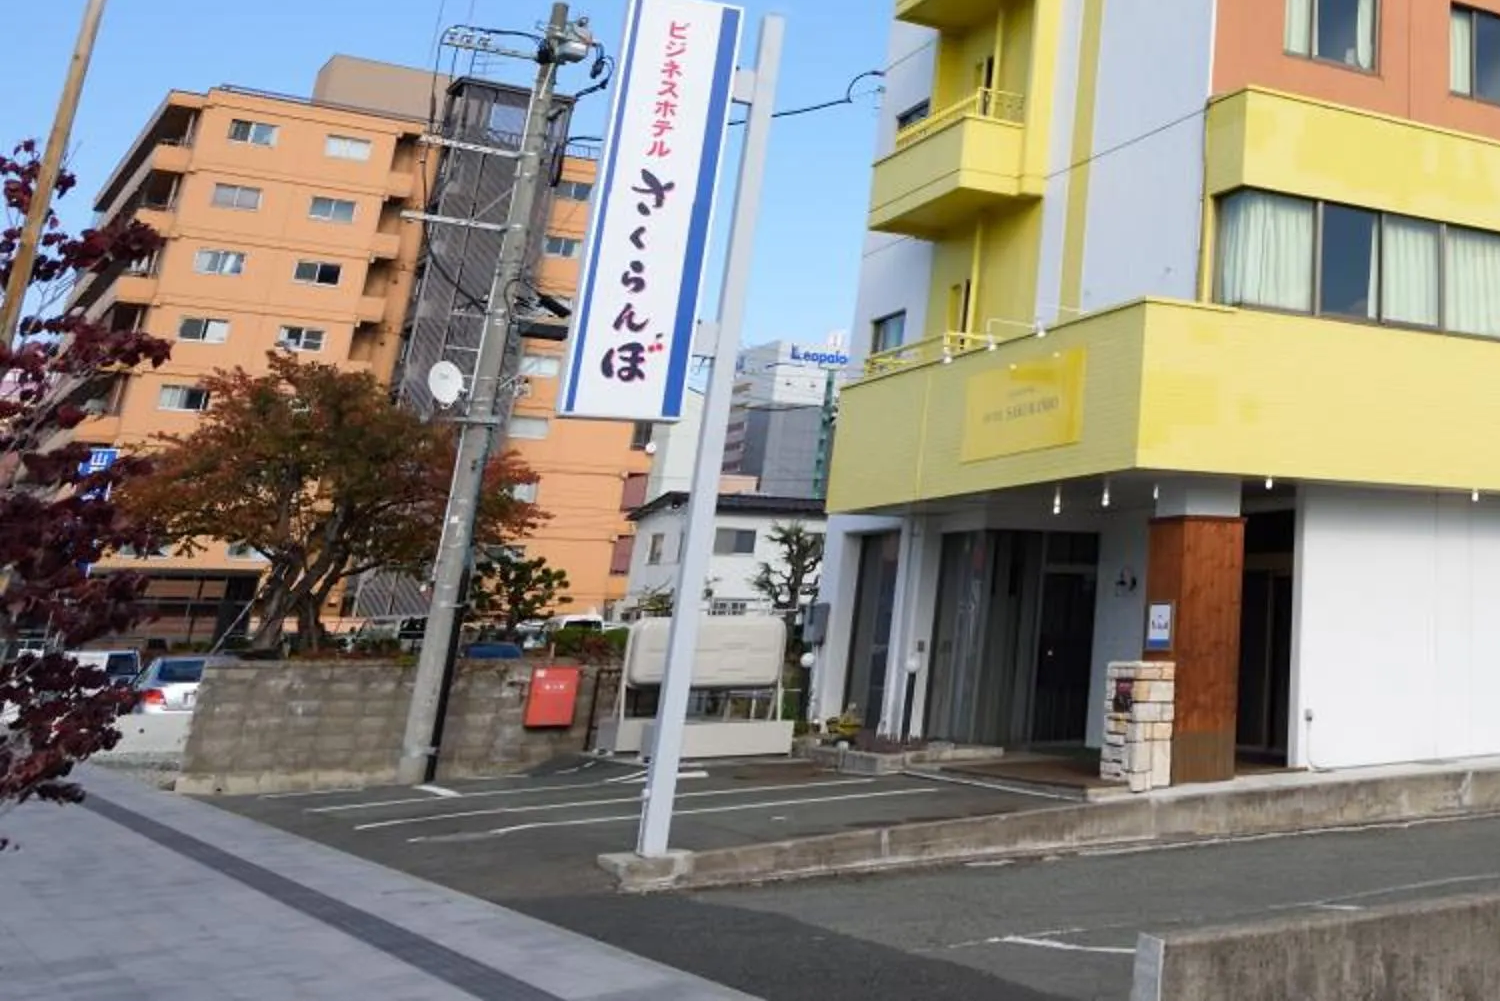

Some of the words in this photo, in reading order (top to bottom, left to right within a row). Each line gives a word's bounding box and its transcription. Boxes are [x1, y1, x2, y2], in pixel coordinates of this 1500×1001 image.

[645, 20, 691, 158] ビジネスホテル
[601, 168, 675, 382] さくらんぼ
